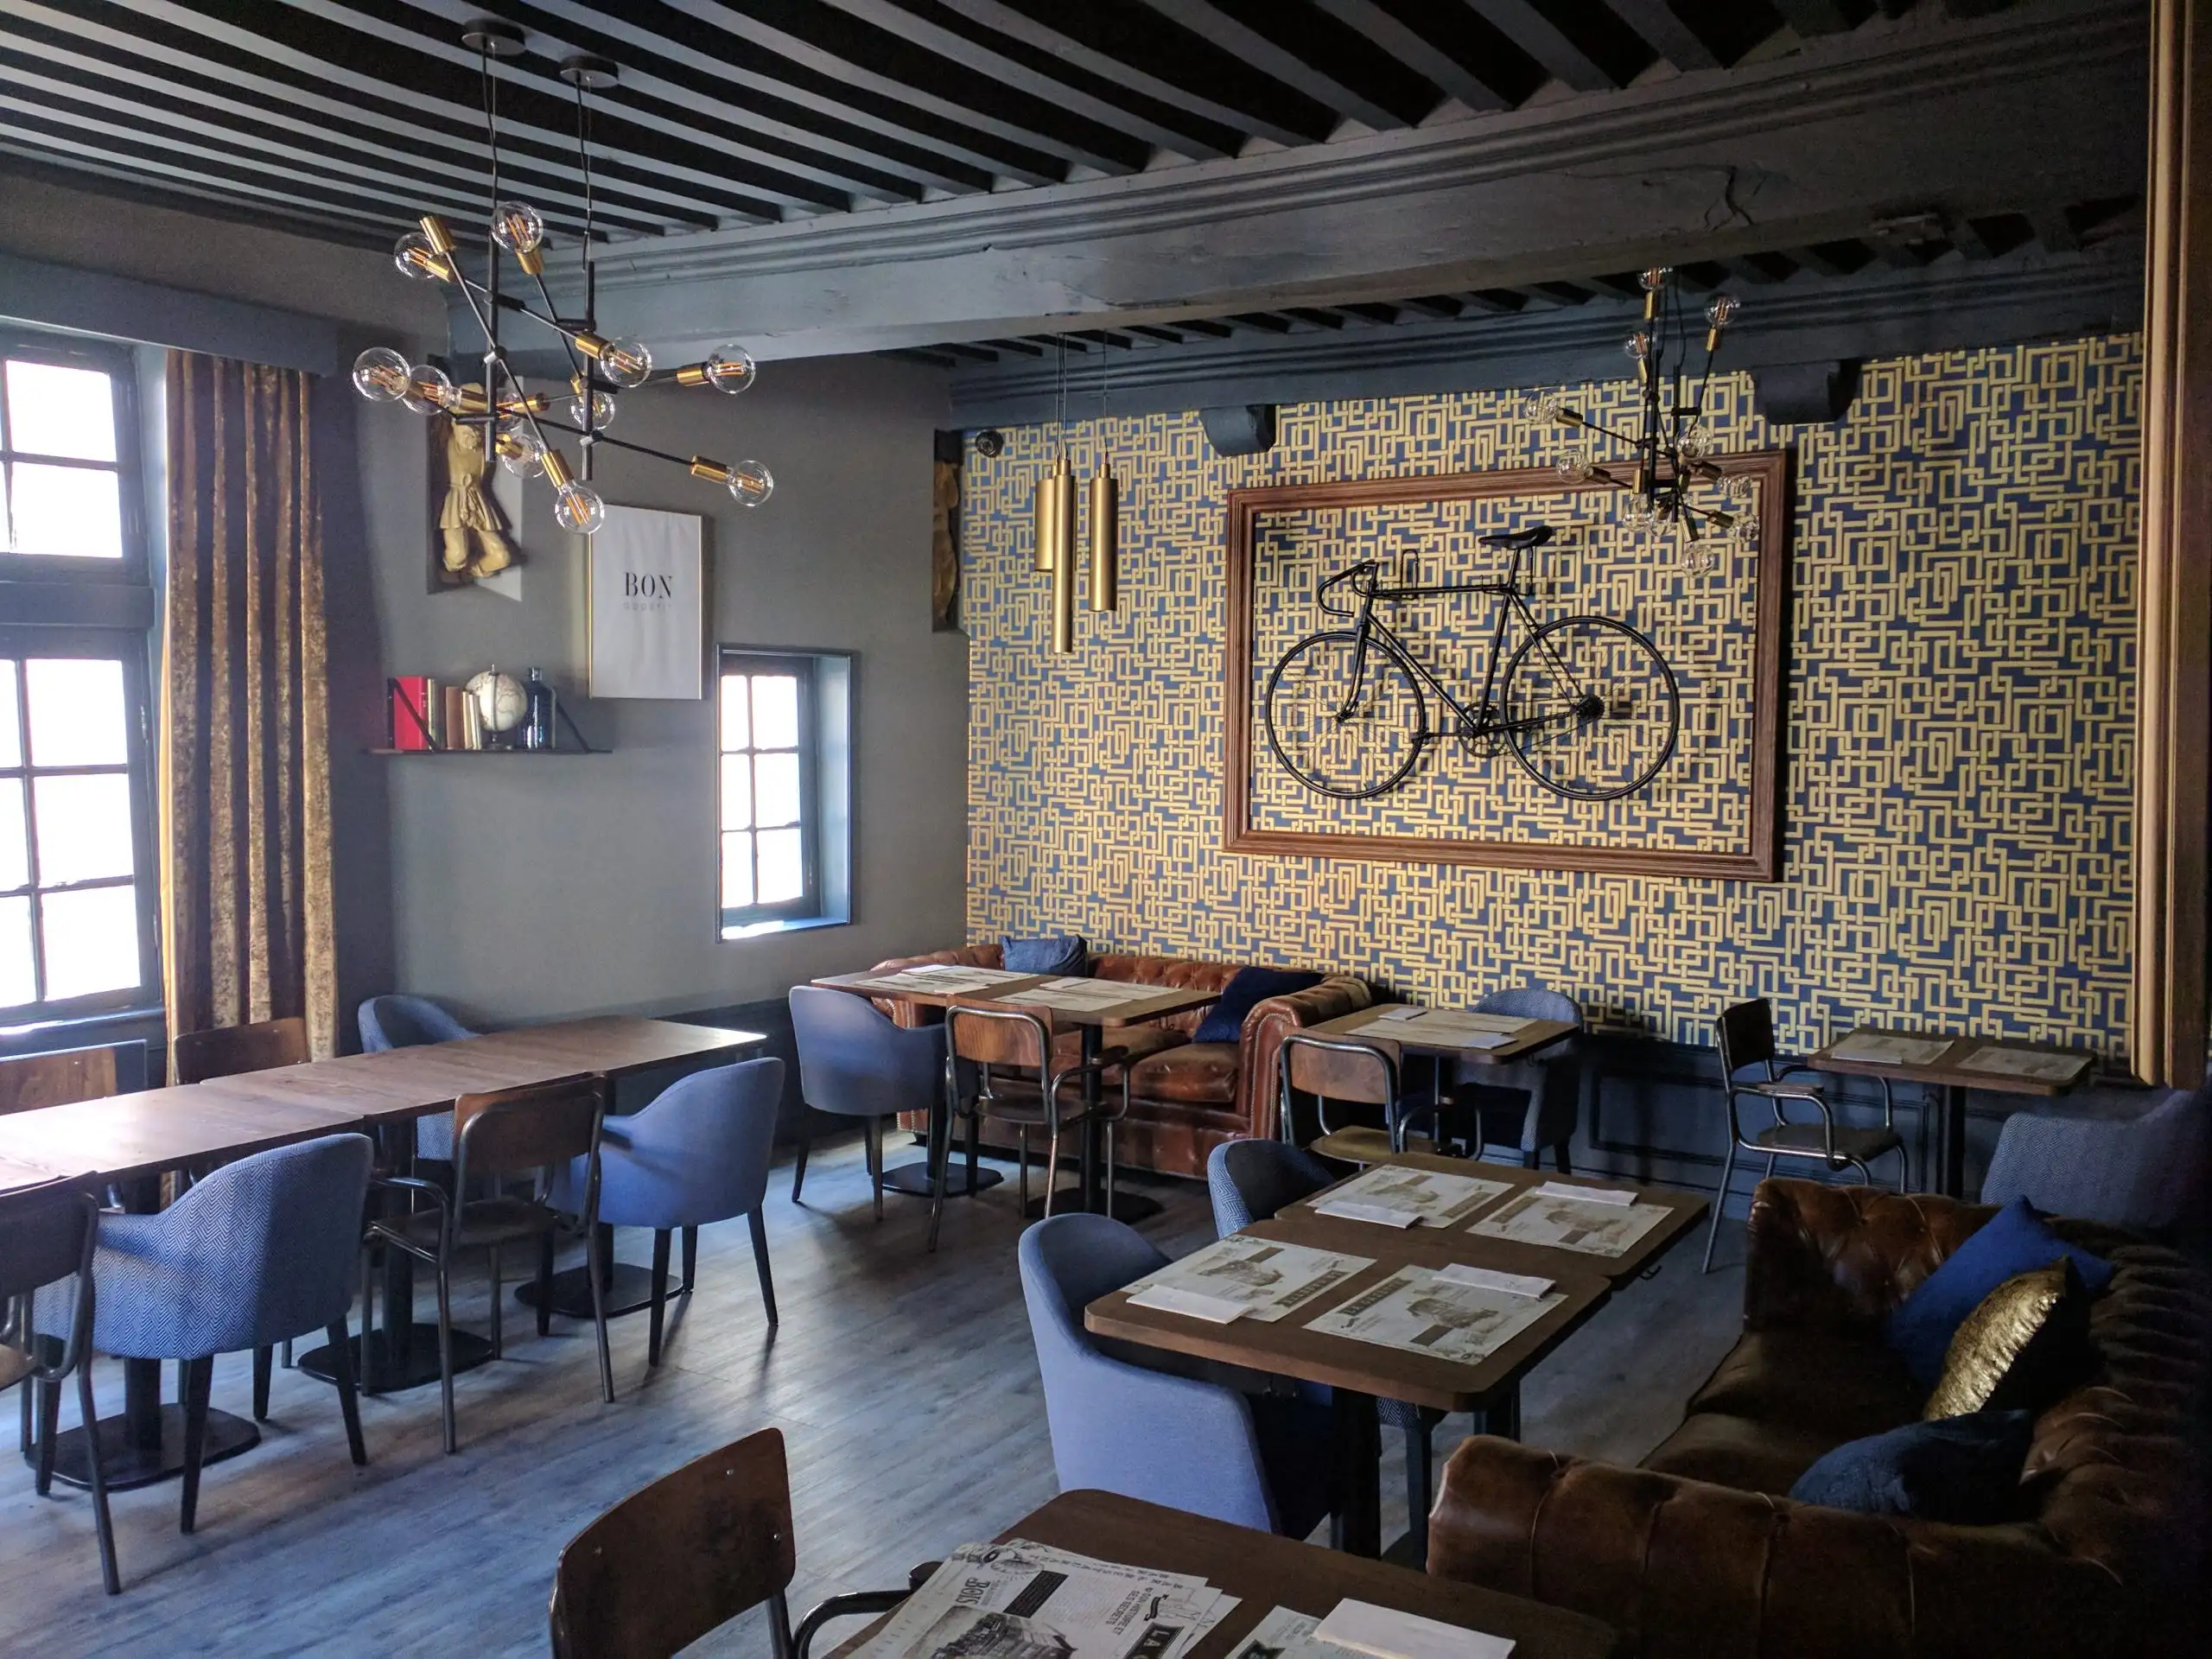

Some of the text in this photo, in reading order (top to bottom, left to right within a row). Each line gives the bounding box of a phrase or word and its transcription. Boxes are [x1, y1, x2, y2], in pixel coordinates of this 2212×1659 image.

[623, 571, 672, 600] BON
[955, 1577, 991, 1605] BOIS
[1143, 1629, 1171, 1647] LA
